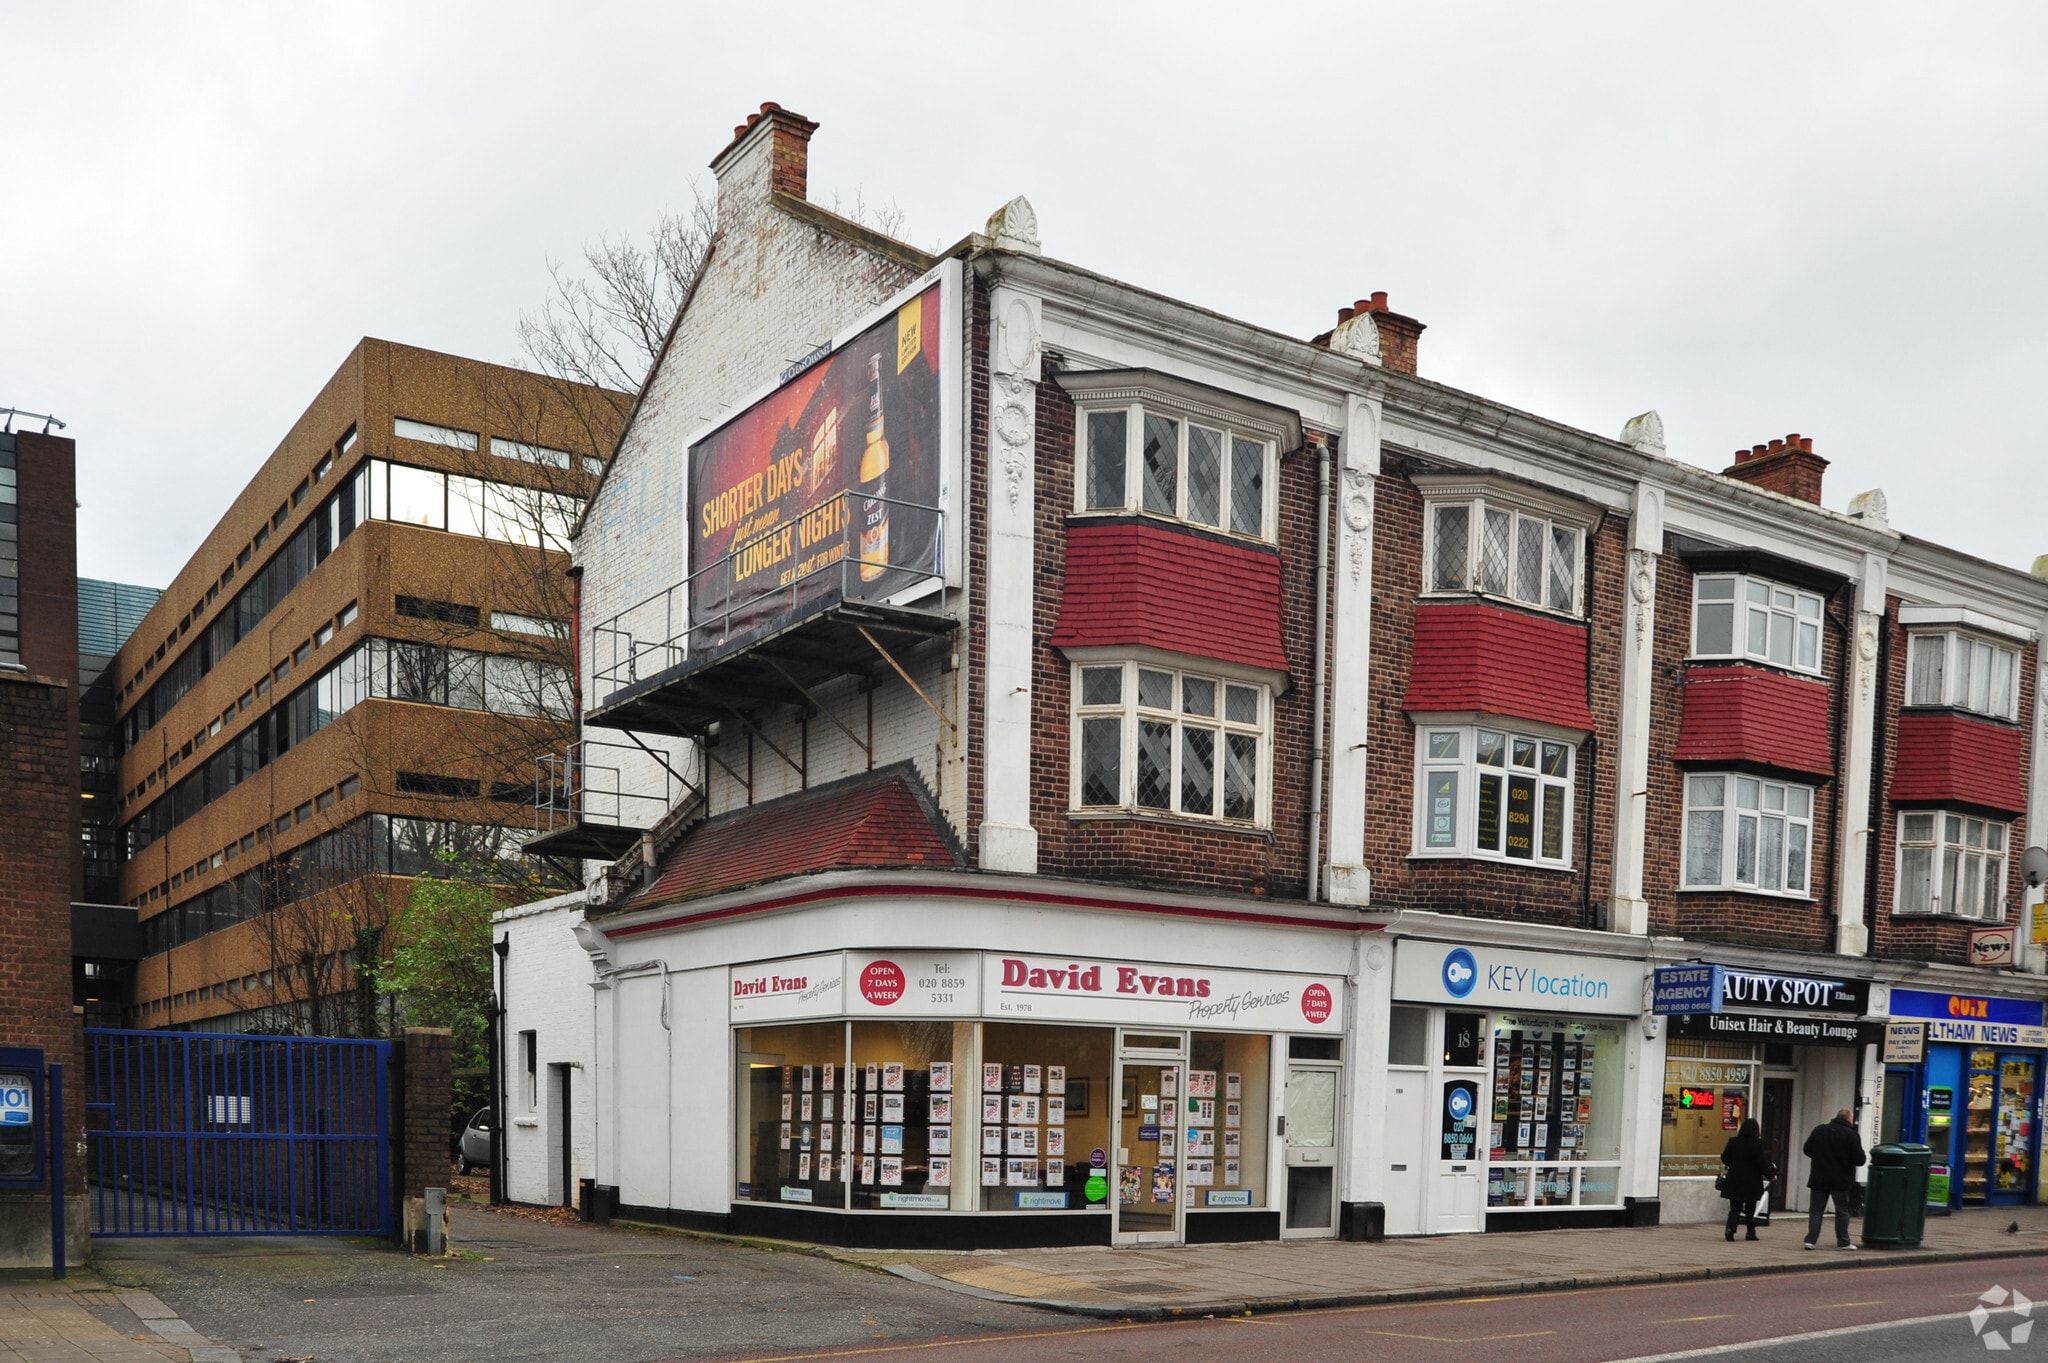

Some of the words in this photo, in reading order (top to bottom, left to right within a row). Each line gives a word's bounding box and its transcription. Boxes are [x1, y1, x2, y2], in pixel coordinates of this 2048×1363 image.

[901, 323, 917, 348] NEW
[702, 472, 764, 539] SHORTER
[767, 448, 803, 503] DAYS
[867, 510, 884, 526] ZEST
[729, 517, 753, 553] just
[735, 520, 793, 583] LONGER
[816, 551, 828, 569] FOR
[828, 540, 850, 564] WINTR
[1512, 788, 1529, 801] 020
[1508, 812, 1530, 825] 8294
[1508, 836, 1530, 849] 0222
[1973, 943, 2011, 953] News
[869, 967, 895, 976] OPEN
[933, 963, 950, 974] Tel:
[867, 979, 873, 987] 7
[874, 979, 898, 988] DAYS
[918, 978, 937, 988] 020
[941, 978, 965, 988] 8859
[1001, 959, 1102, 992] David
[1116, 967, 1211, 998] Evans
[1488, 964, 1529, 993] KEY
[1531, 968, 1609, 999] location
[1660, 970, 1709, 984] ESTATE
[734, 978, 767, 996] David
[771, 976, 808, 993] Evans
[1308, 989, 1326, 997] OPEN
[1657, 986, 1711, 1000] AGENCY
[1722, 974, 1778, 1002] AUTY
[1781, 979, 1834, 1007] SPOT
[930, 993, 953, 1003] 5331
[1311, 1000, 1327, 1008] DAYS
[1000, 1003, 1013, 1011] Est.
[1016, 1004, 1032, 1012] 1978
[1189, 993, 1241, 1022] Property
[1242, 989, 1290, 1011] Services
[1311, 1011, 1328, 1019] WEEK
[1709, 1015, 1746, 1032] Unisex
[1748, 1018, 1773, 1034] Hair
[1775, 1020, 1784, 1034] &
[1786, 1020, 1820, 1039] Beauty
[1822, 1023, 1858, 1041] Lounge
[1890, 1026, 1921, 1035] NEWS
[1981, 1025, 2018, 1044] NEWS
[1457, 1033, 1470, 1049] 18
[1724, 1067, 1747, 1081] 4959
[0, 1088, 29, 1107] 101
